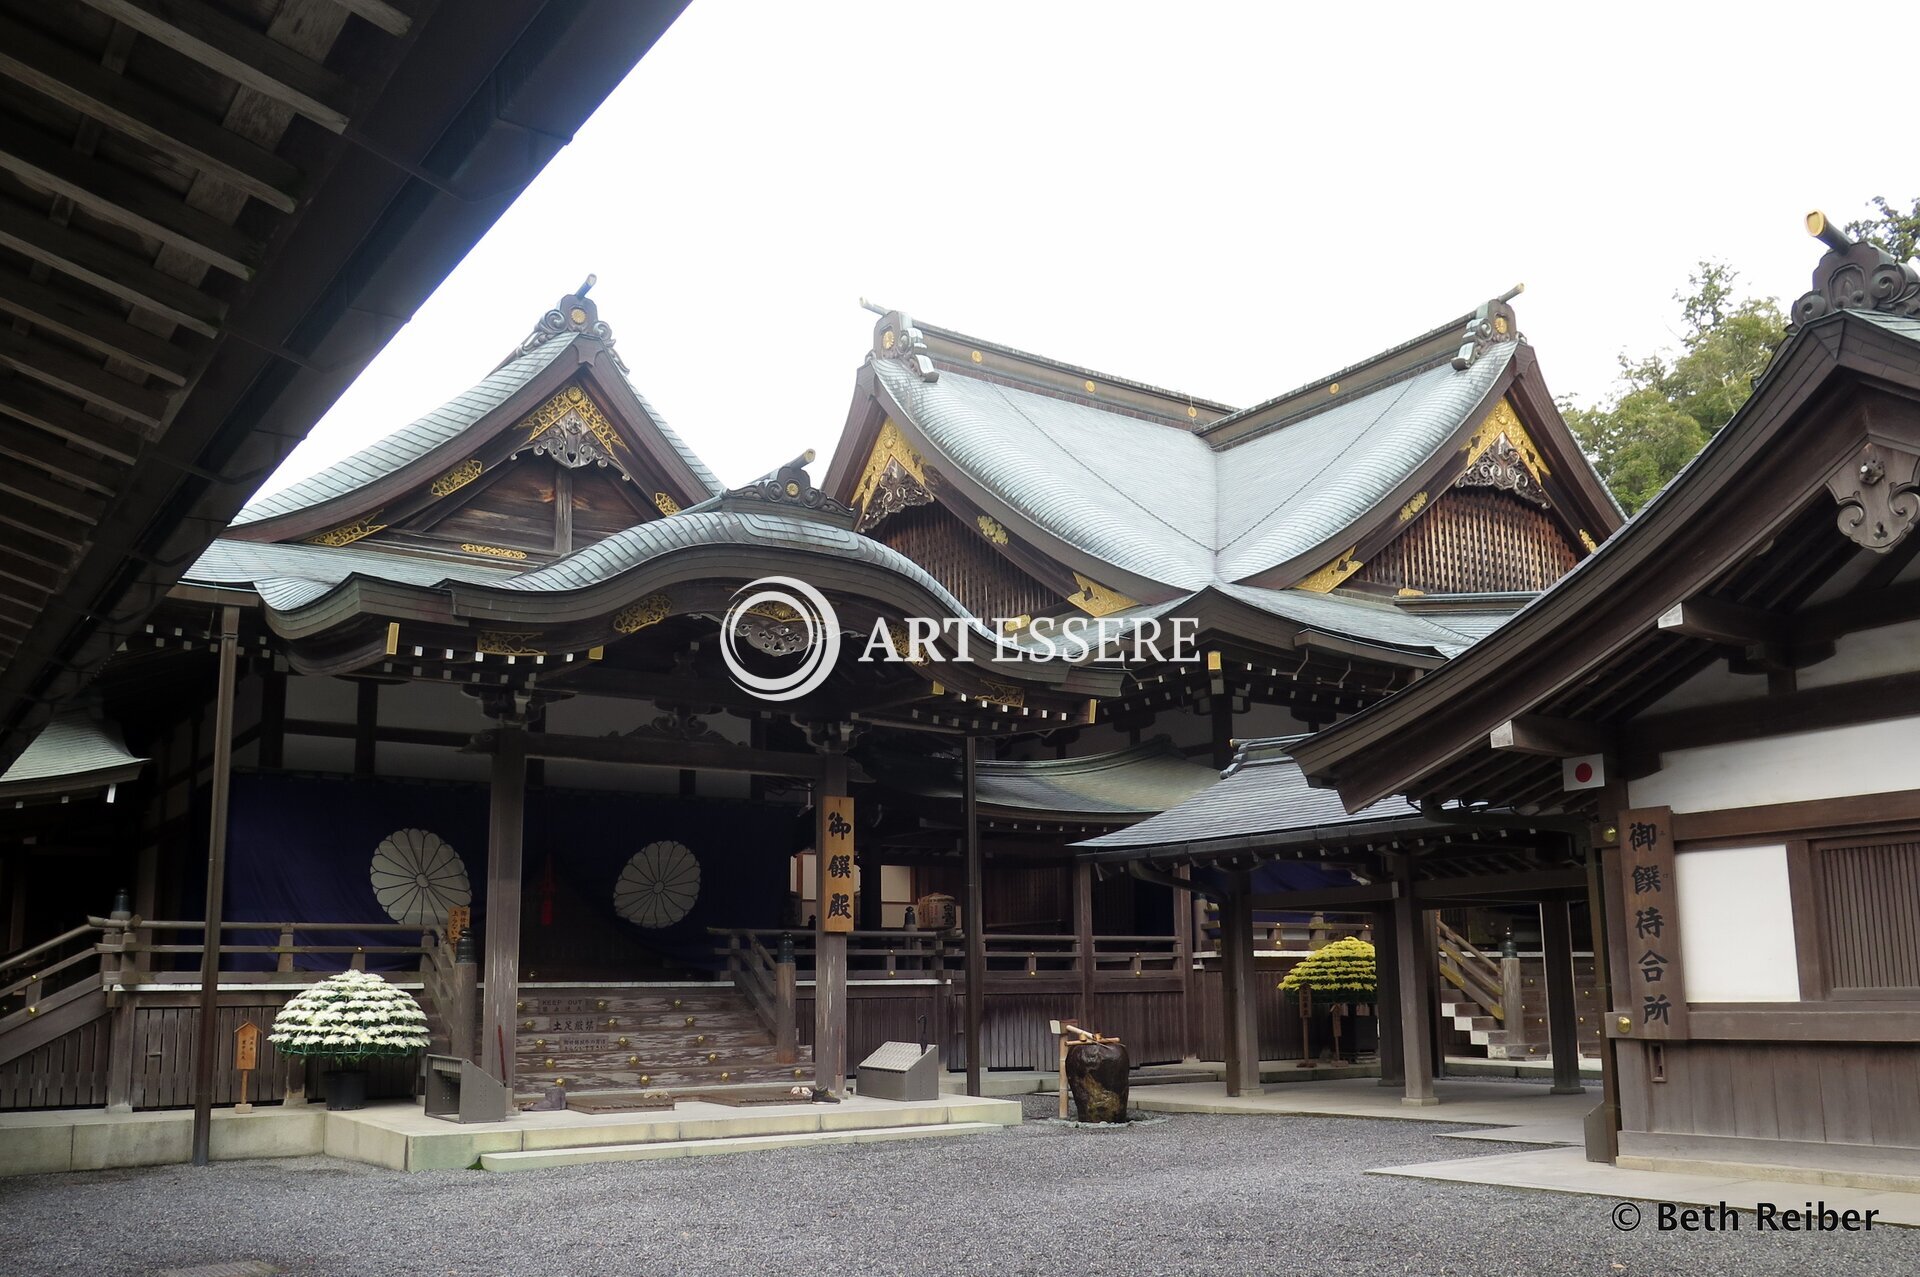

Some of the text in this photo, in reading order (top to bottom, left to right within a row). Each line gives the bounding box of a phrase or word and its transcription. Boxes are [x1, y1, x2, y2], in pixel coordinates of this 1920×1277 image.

[827, 811, 852, 920] 御饌殿
[1629, 821, 1672, 1026] 御饌待合所
[553, 1018, 594, 1031] 土足厳禁
